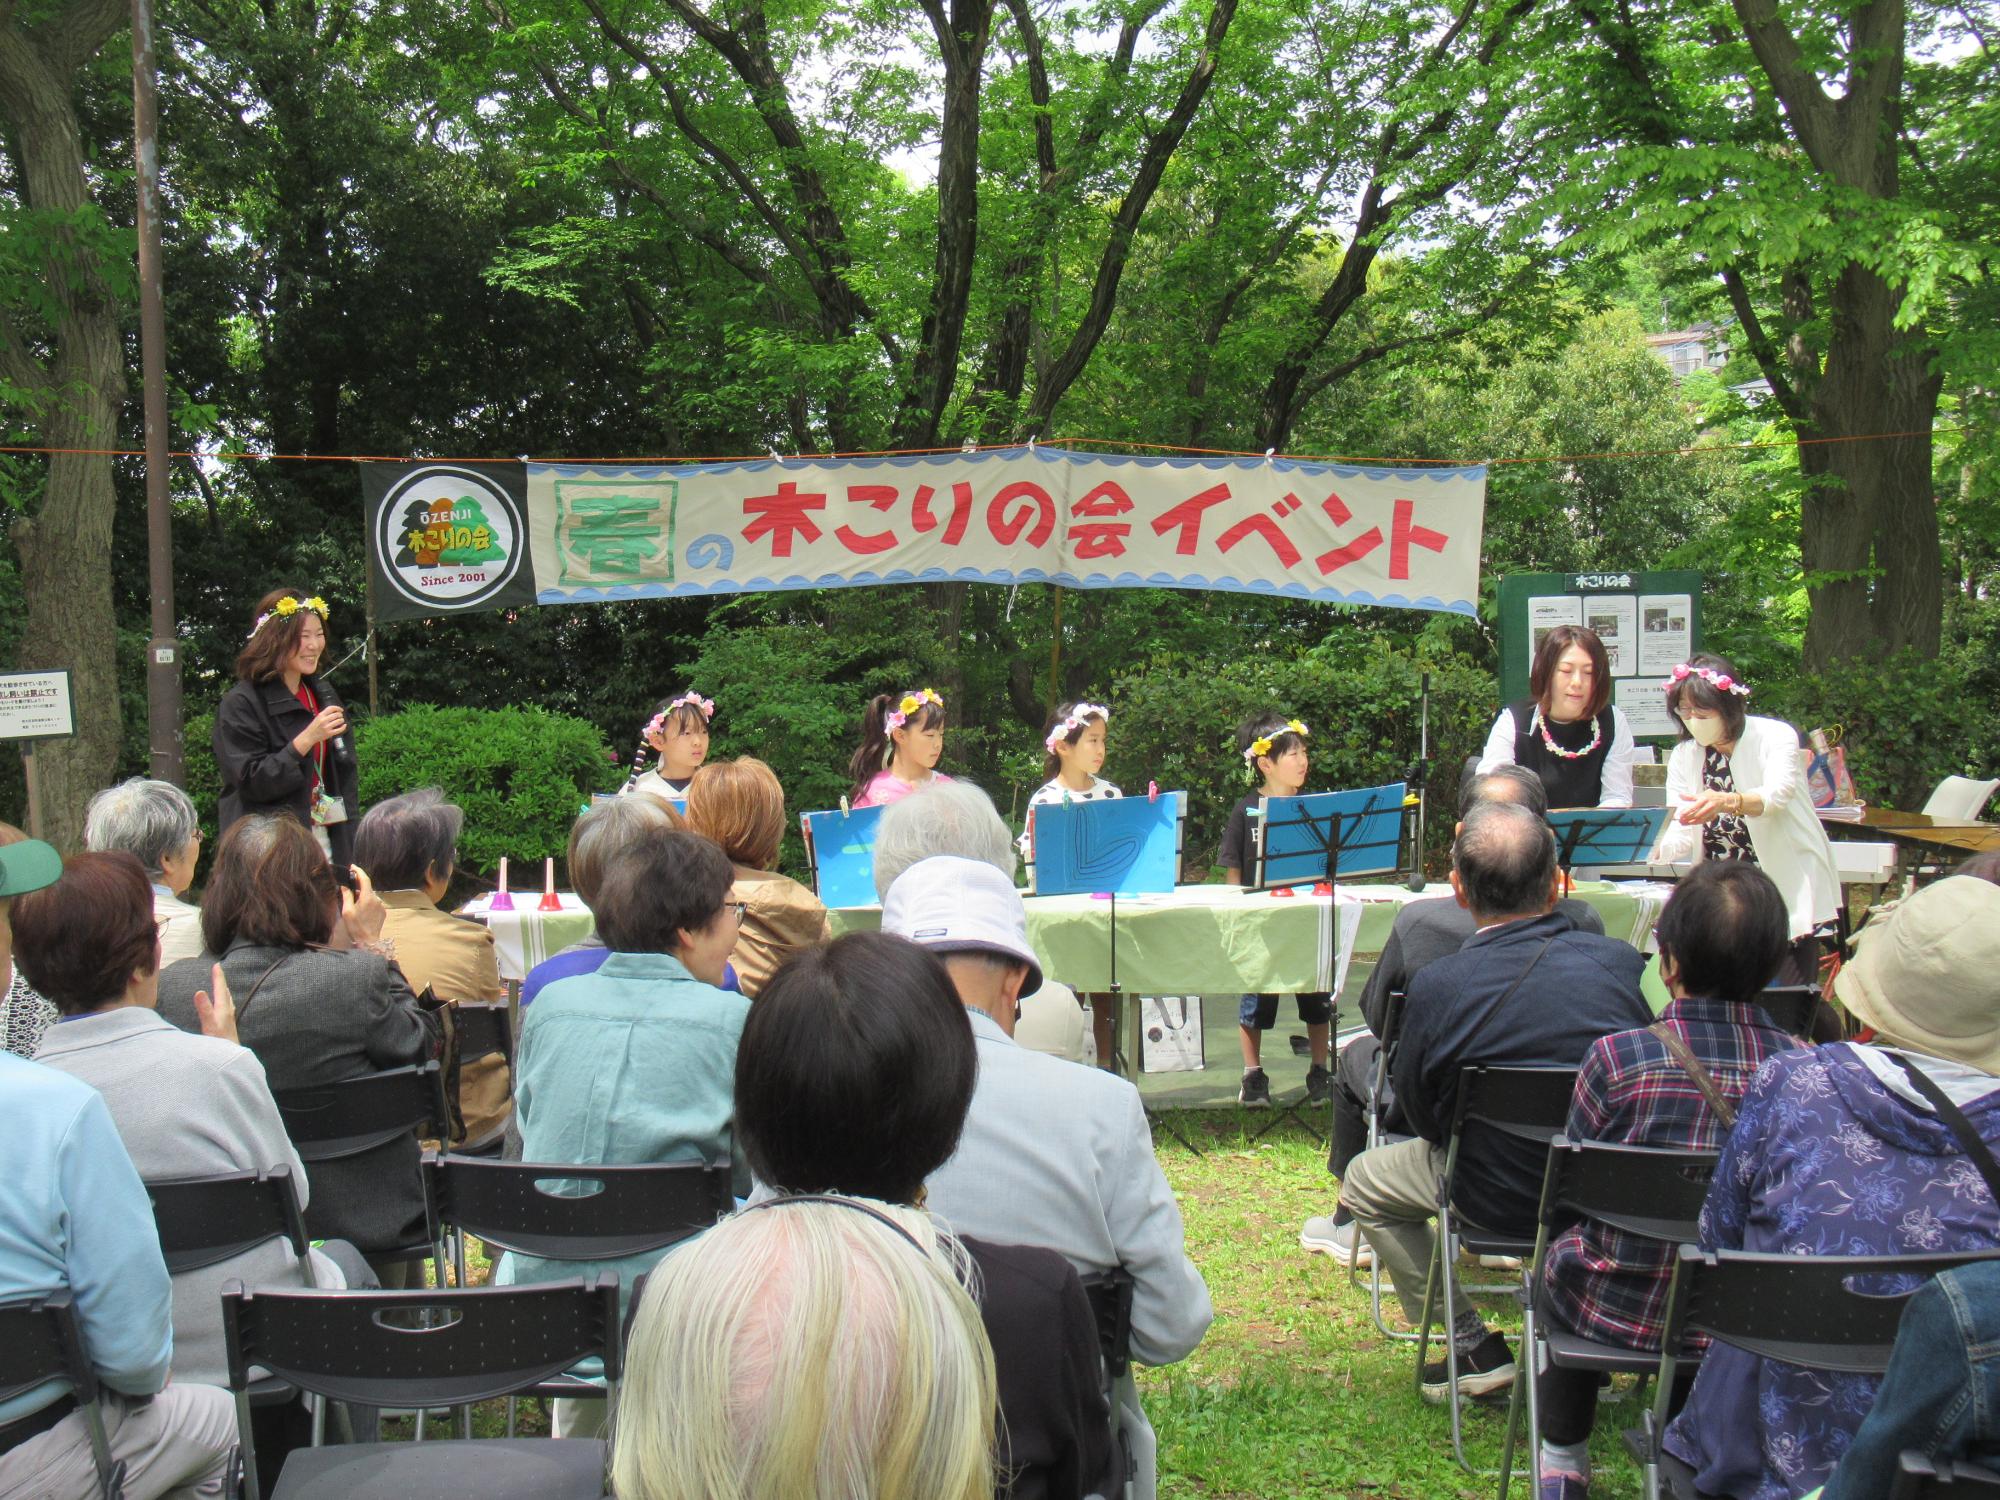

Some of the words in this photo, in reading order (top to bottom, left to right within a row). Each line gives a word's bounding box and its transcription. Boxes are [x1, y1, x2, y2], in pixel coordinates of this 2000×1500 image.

[408, 525, 491, 553] 木こりの会
[569, 480, 1449, 580] 春の木こりの会イベント
[421, 575, 454, 587] Since
[458, 572, 486, 583] 2001
[1575, 574, 1632, 589] 木こりの会
